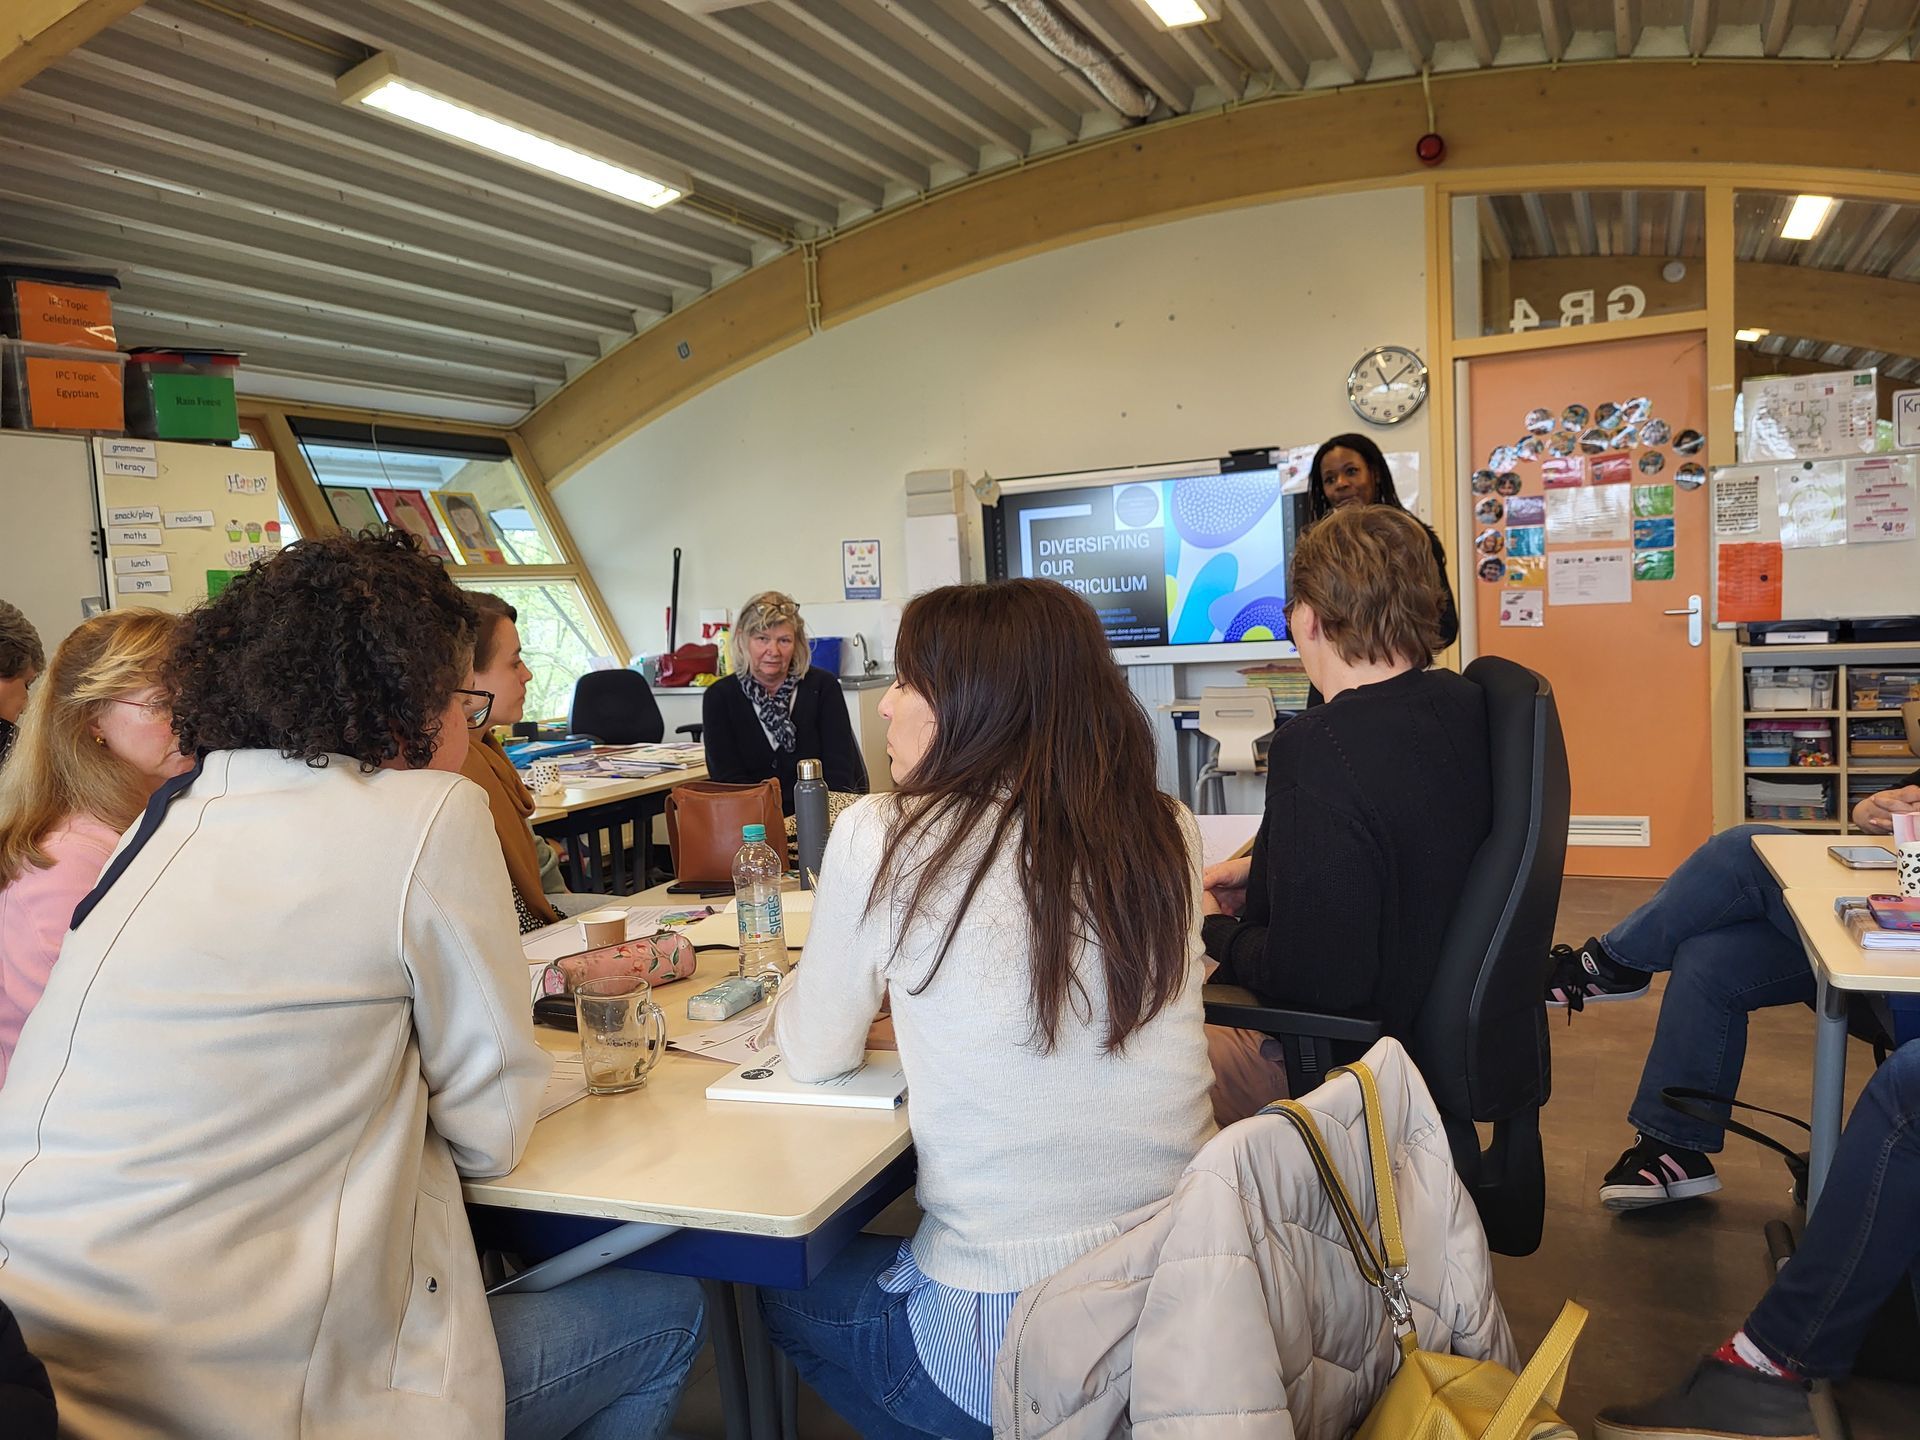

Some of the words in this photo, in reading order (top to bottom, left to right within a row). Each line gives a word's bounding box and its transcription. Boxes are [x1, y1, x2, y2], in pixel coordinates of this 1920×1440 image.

[66, 299, 89, 312] Topic
[42, 313, 97, 328] Celebrations
[55, 370, 71, 382] IPC
[73, 371, 97, 383] Topic
[56, 387, 100, 400] Egyptians
[176, 396, 196, 406] Rain
[112, 445, 146, 454] grammar
[115, 461, 146, 473] literacy
[228, 473, 268, 493] Happy
[114, 508, 154, 520] snack/play
[175, 514, 203, 524] reading
[123, 532, 147, 541] maths
[1039, 532, 1150, 556] DIVERSIFYING
[130, 559, 151, 568] lunch
[1039, 559, 1075, 577] OUR
[136, 581, 153, 590] gym
